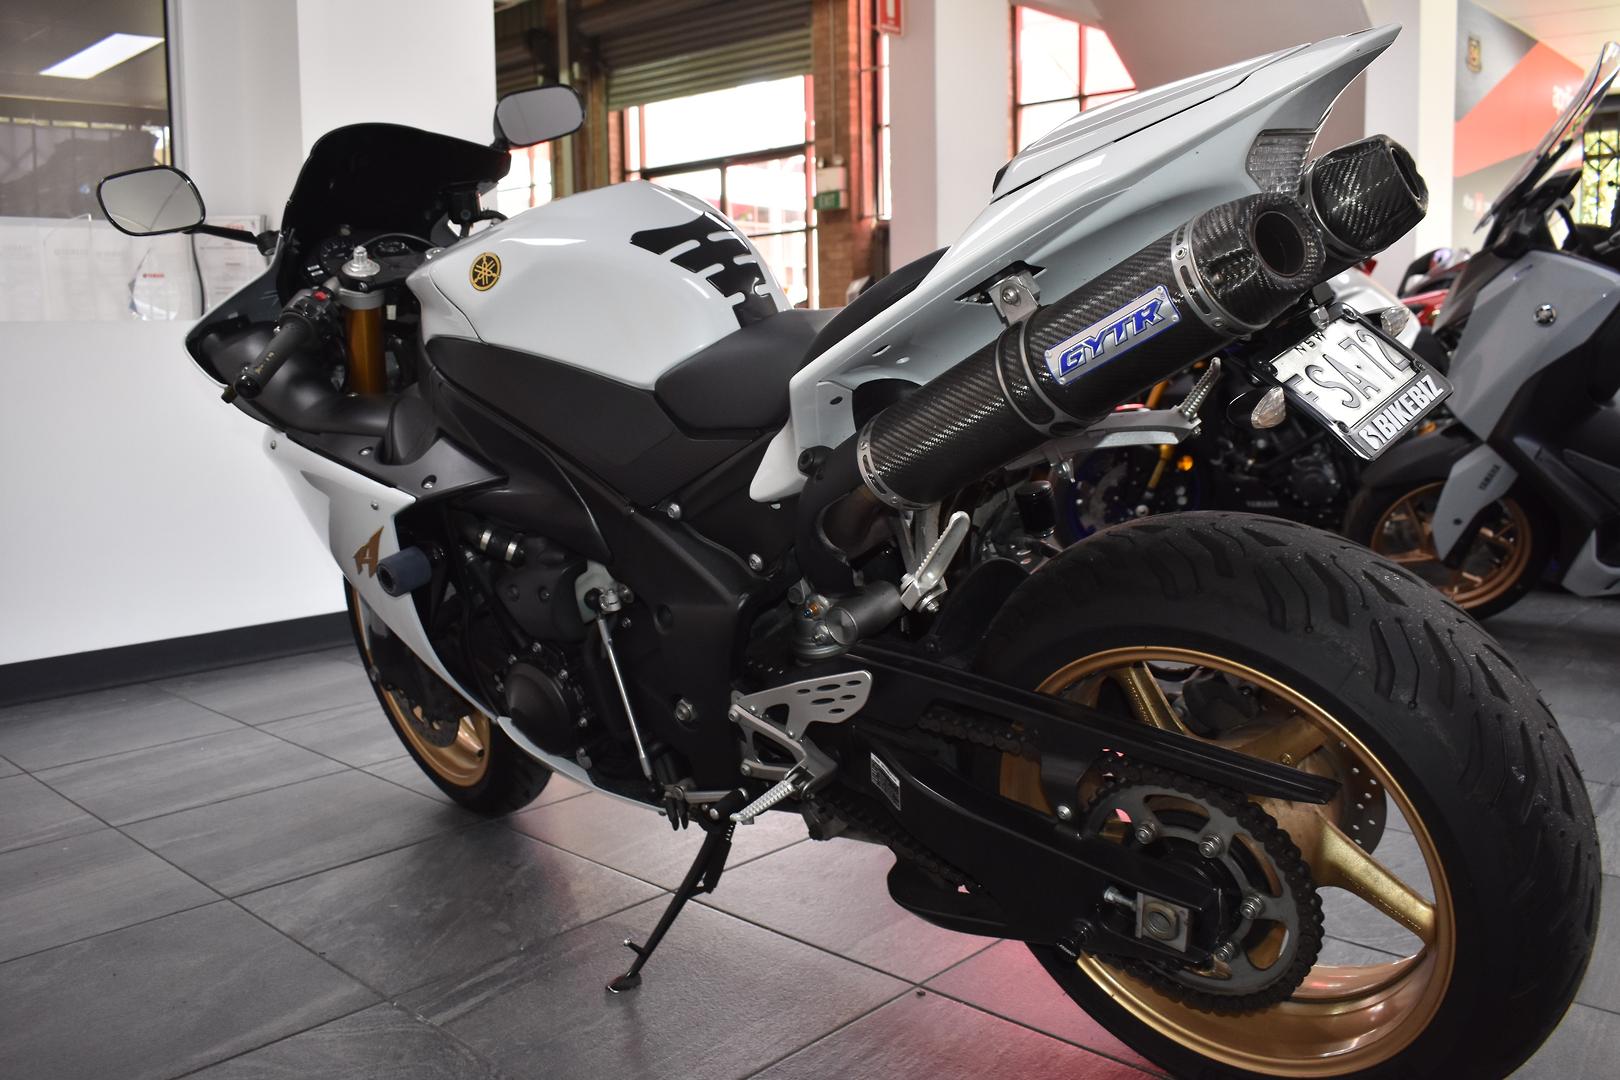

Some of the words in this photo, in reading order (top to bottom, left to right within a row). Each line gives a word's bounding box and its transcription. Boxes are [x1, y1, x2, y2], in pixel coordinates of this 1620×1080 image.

[1058, 298, 1165, 377] GYTR
[1295, 331, 1326, 355] NSW
[1372, 374, 1444, 441] BIKEBIZ
[1478, 464, 1501, 490] YAMAHA
